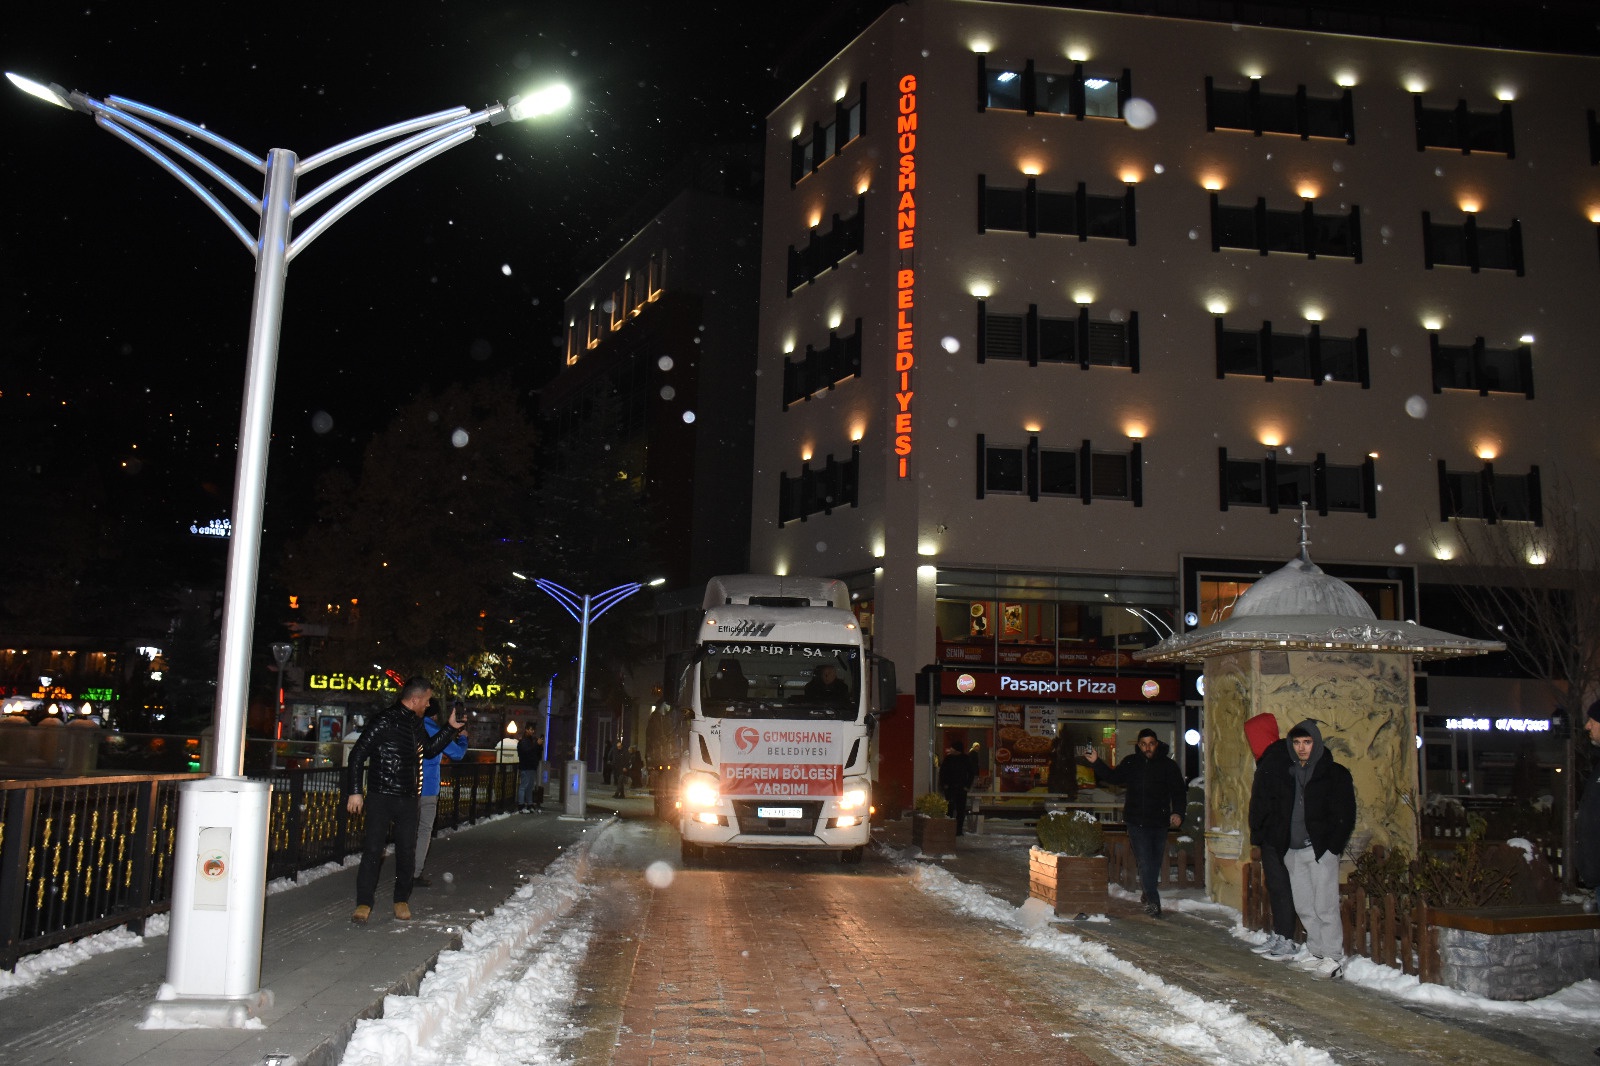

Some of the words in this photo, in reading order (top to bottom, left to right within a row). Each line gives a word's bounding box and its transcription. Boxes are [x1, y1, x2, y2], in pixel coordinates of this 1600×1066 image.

[309, 672, 398, 692] GÖNÜL
[1000, 675, 1073, 695] Pasaport
[1077, 679, 1117, 694] Pizza
[763, 731, 832, 745] GÜMÜŞHANE
[726, 767, 779, 780] DEPREM
[782, 764, 837, 781] BÖLGESİ
[754, 782, 809, 796] YARDIMI
